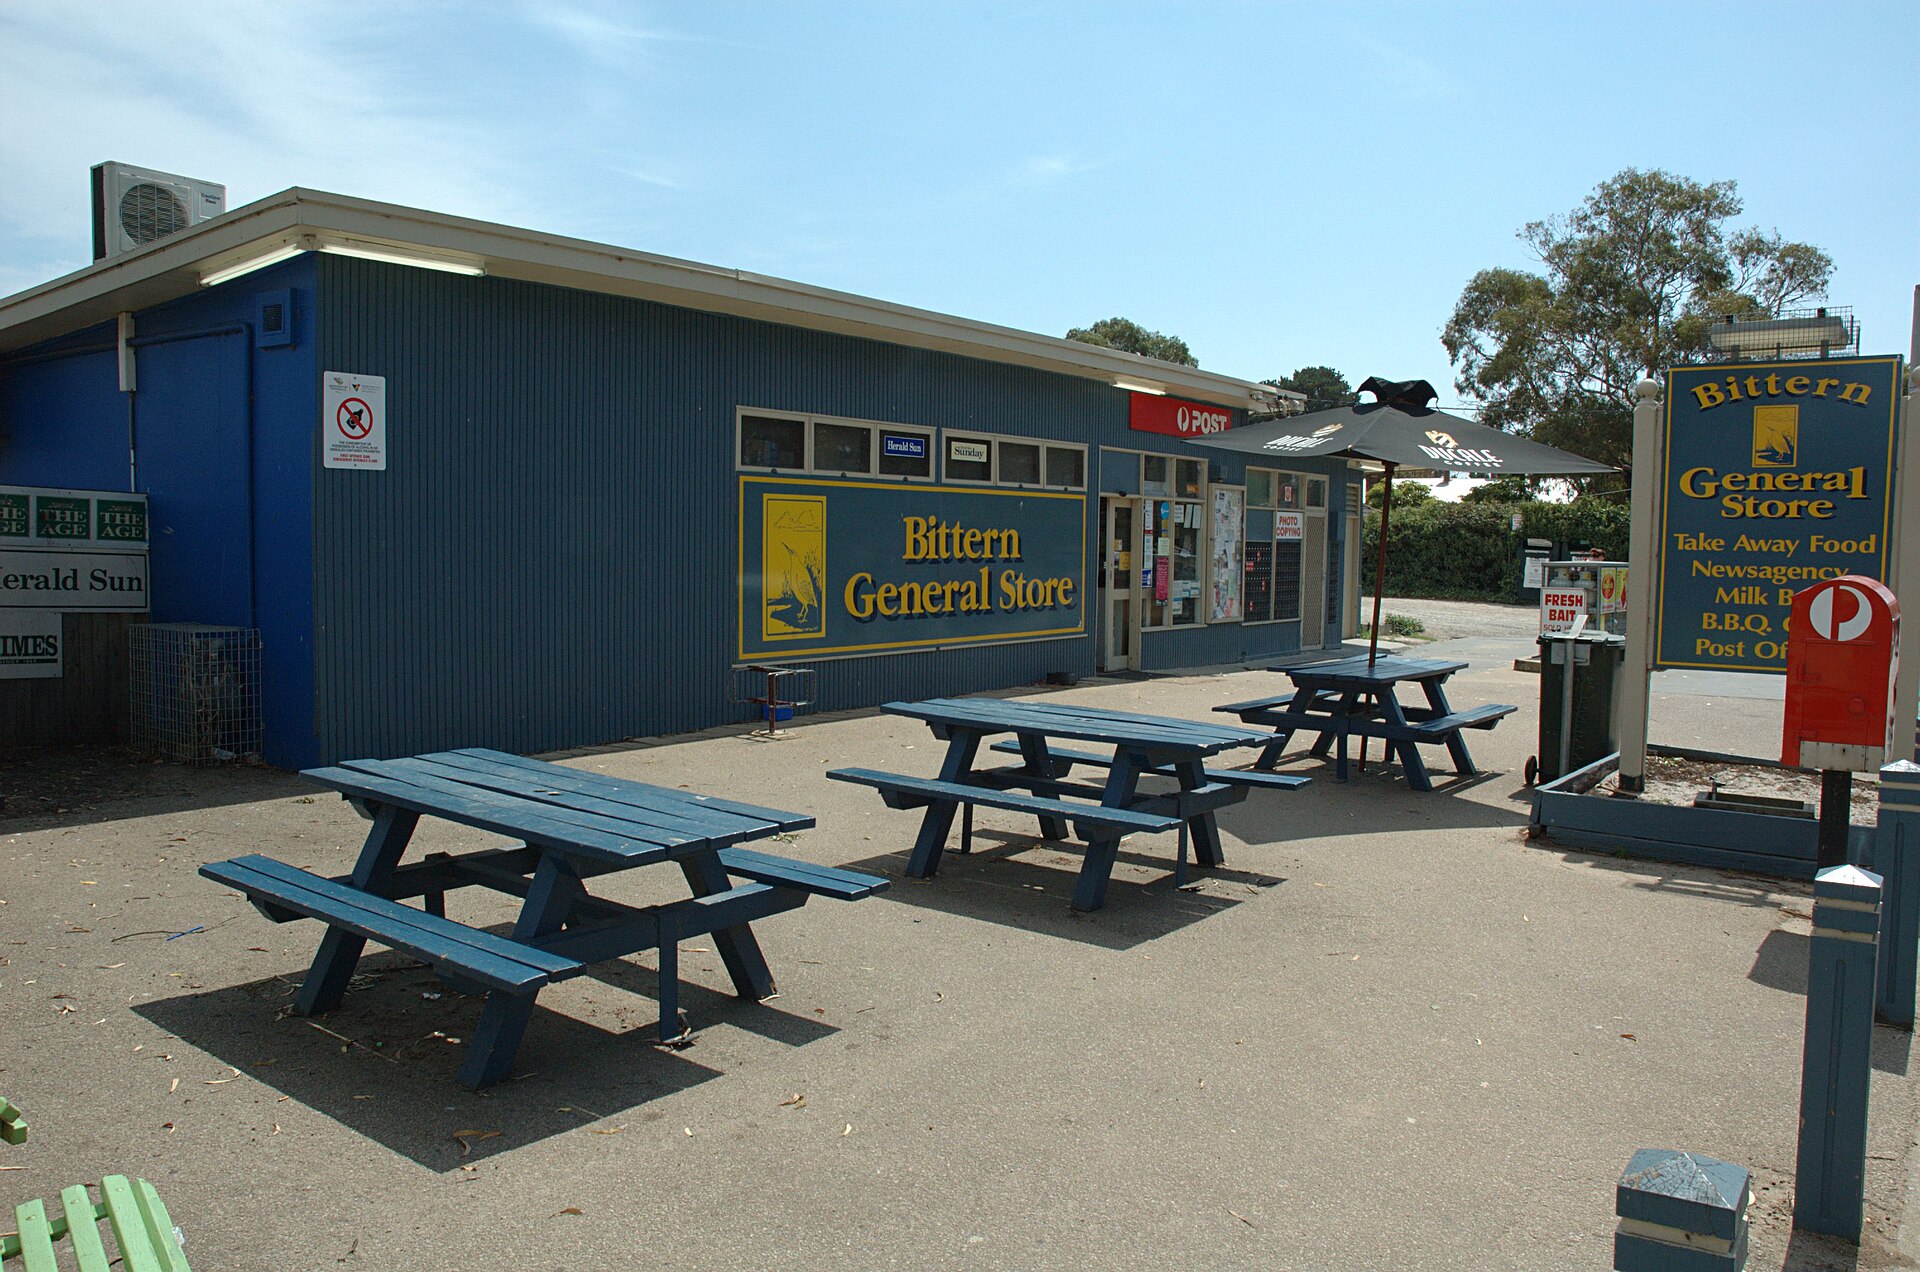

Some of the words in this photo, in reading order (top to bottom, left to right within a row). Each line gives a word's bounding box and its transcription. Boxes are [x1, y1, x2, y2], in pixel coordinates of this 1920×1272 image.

[1691, 372, 1873, 411] Bittern
[1191, 410, 1228, 435] POST
[888, 440, 909, 452] Herald
[909, 443, 922, 453] Sun
[954, 446, 984, 459] Sunday
[1417, 444, 1504, 463] DUCALE
[1679, 466, 1869, 500] General
[0, 507, 26, 520] HE
[1721, 494, 1834, 519] Store
[39, 509, 87, 523] THE
[100, 512, 143, 525] THE
[1279, 516, 1298, 526] PHOTO
[41, 523, 87, 536] AGE
[101, 525, 143, 538] AGE
[901, 515, 1021, 561] Bittern
[1276, 527, 1301, 537] COPYING
[1674, 532, 1725, 552] Take
[1733, 534, 1800, 557] Away
[1809, 534, 1876, 554] Food
[0, 566, 80, 591] erald
[89, 568, 144, 592] Sun
[844, 565, 991, 619] General
[999, 569, 1074, 611] Store
[1544, 594, 1583, 607] FRESH
[1715, 587, 1768, 605] Milk
[1548, 609, 1576, 621] BAIT
[1702, 613, 1772, 636] B.B.Q.
[0, 635, 58, 656] IMES
[1695, 639, 1746, 657] Post
[1754, 641, 1788, 659] Of
